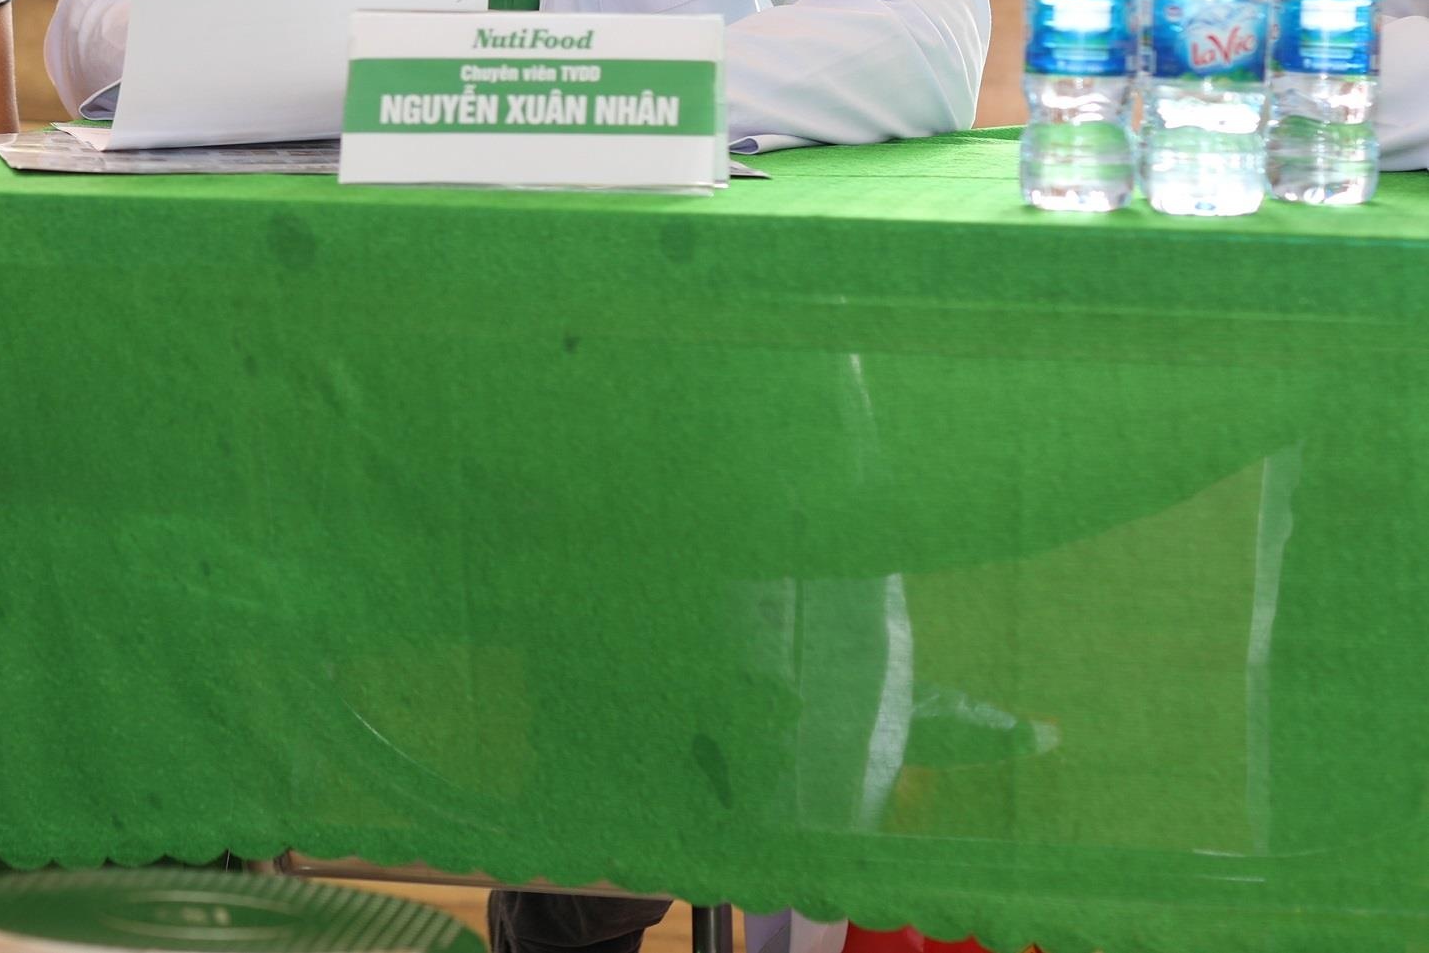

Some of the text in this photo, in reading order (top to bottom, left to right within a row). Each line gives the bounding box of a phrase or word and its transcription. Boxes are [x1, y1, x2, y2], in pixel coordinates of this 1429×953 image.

[472, 27, 595, 50] NutiFood
[460, 63, 520, 84] Chuyên
[522, 63, 558, 82] viên
[379, 84, 680, 126] NGUYỄN XUÂN NHÂN
